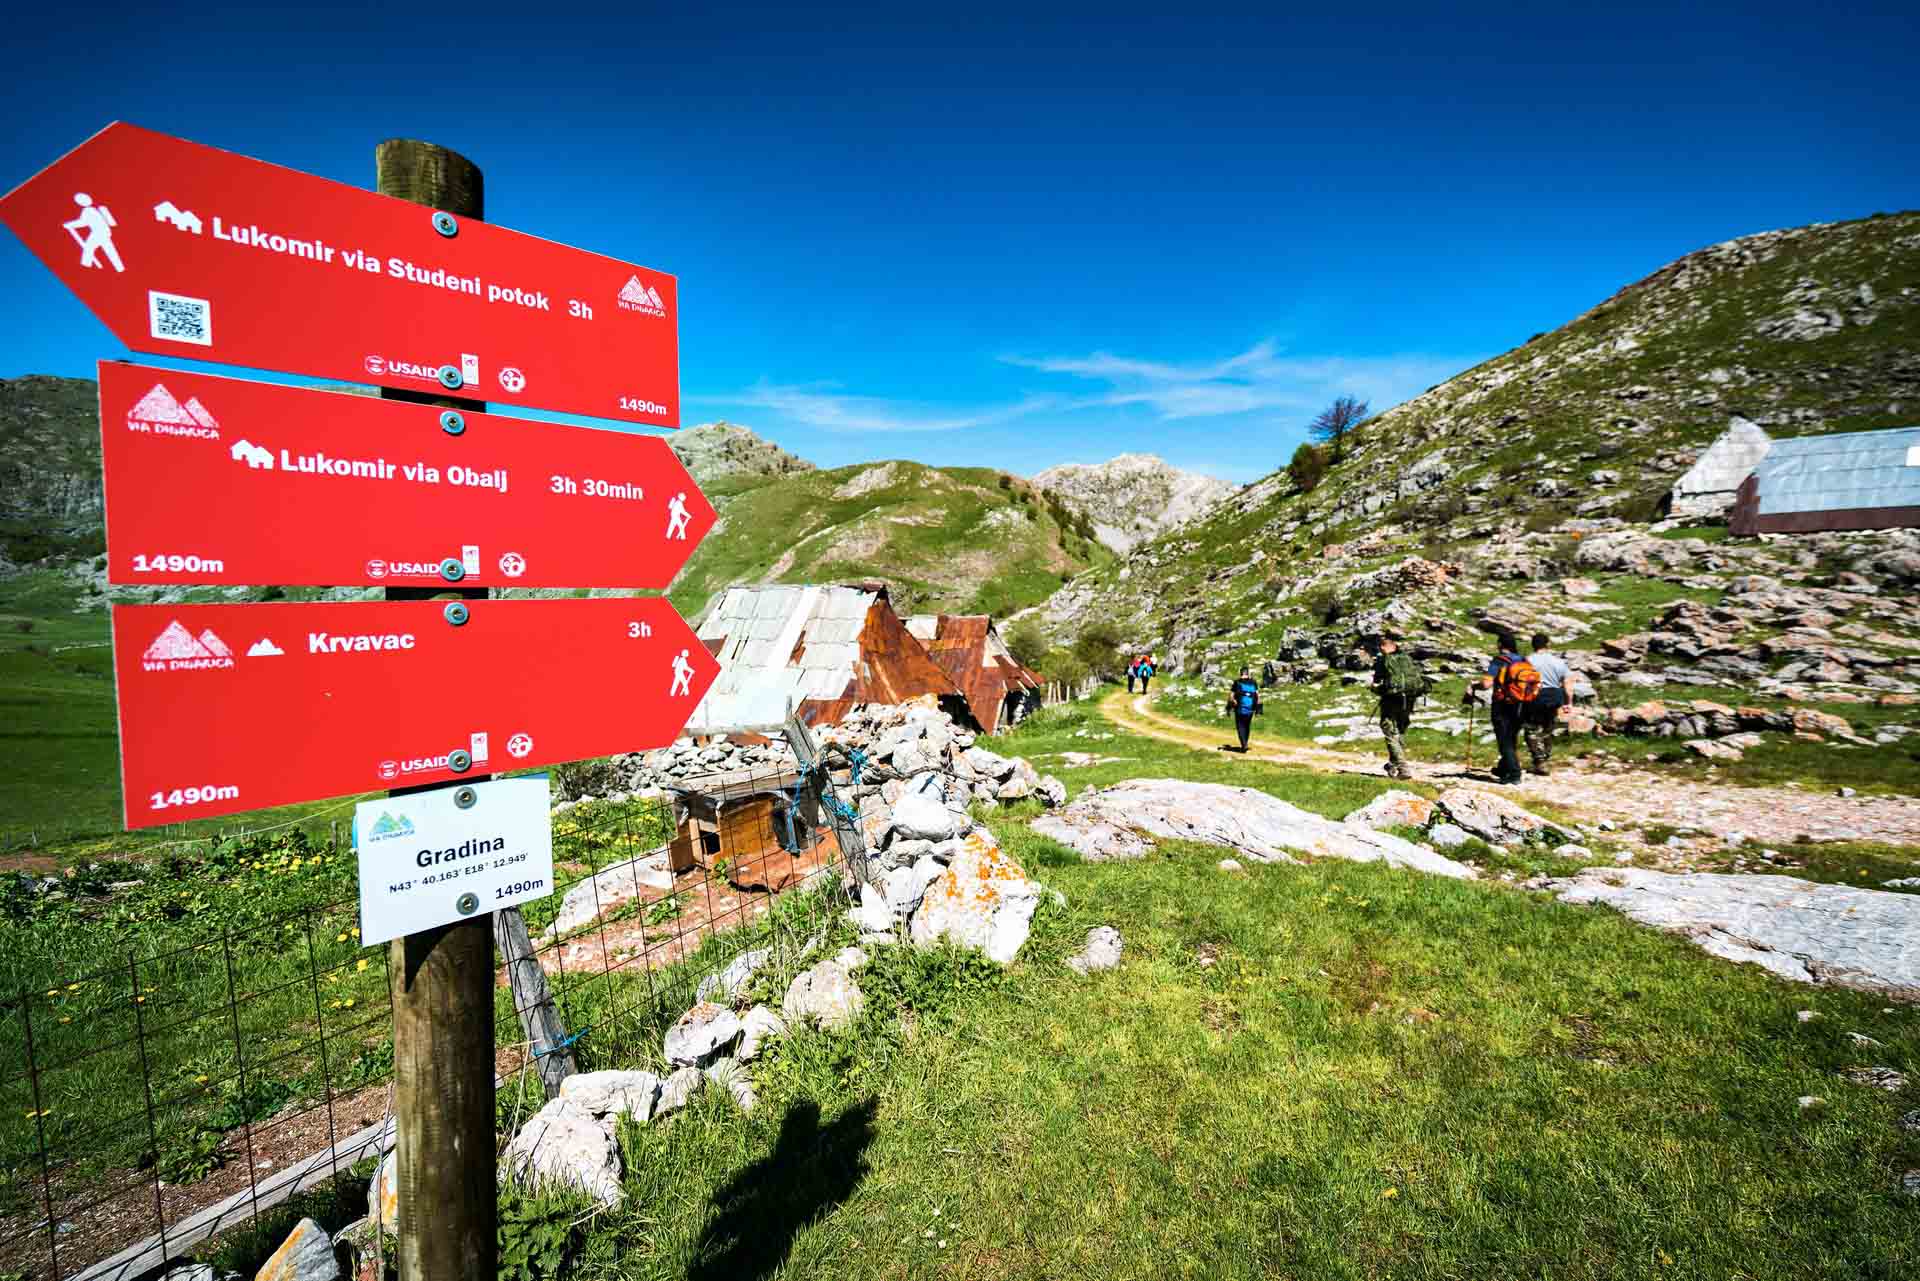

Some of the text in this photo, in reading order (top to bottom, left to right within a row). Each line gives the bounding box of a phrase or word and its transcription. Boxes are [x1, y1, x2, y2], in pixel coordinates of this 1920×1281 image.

[213, 217, 550, 311] Lukomir via Studeni potok
[568, 300, 593, 321] 3h
[389, 361, 440, 379] USAID
[619, 396, 667, 416] 1490m
[281, 450, 508, 493] Lukomir via Obalj
[550, 475, 644, 500] 3h 30min
[133, 555, 224, 573] 1490m
[390, 562, 440, 574] USAID
[628, 622, 652, 638] 3h
[308, 632, 415, 654] Krvavac
[401, 755, 449, 772] USAID
[151, 785, 239, 810] 1490m
[416, 837, 505, 868] Gradina
[495, 879, 544, 900] 1490m
